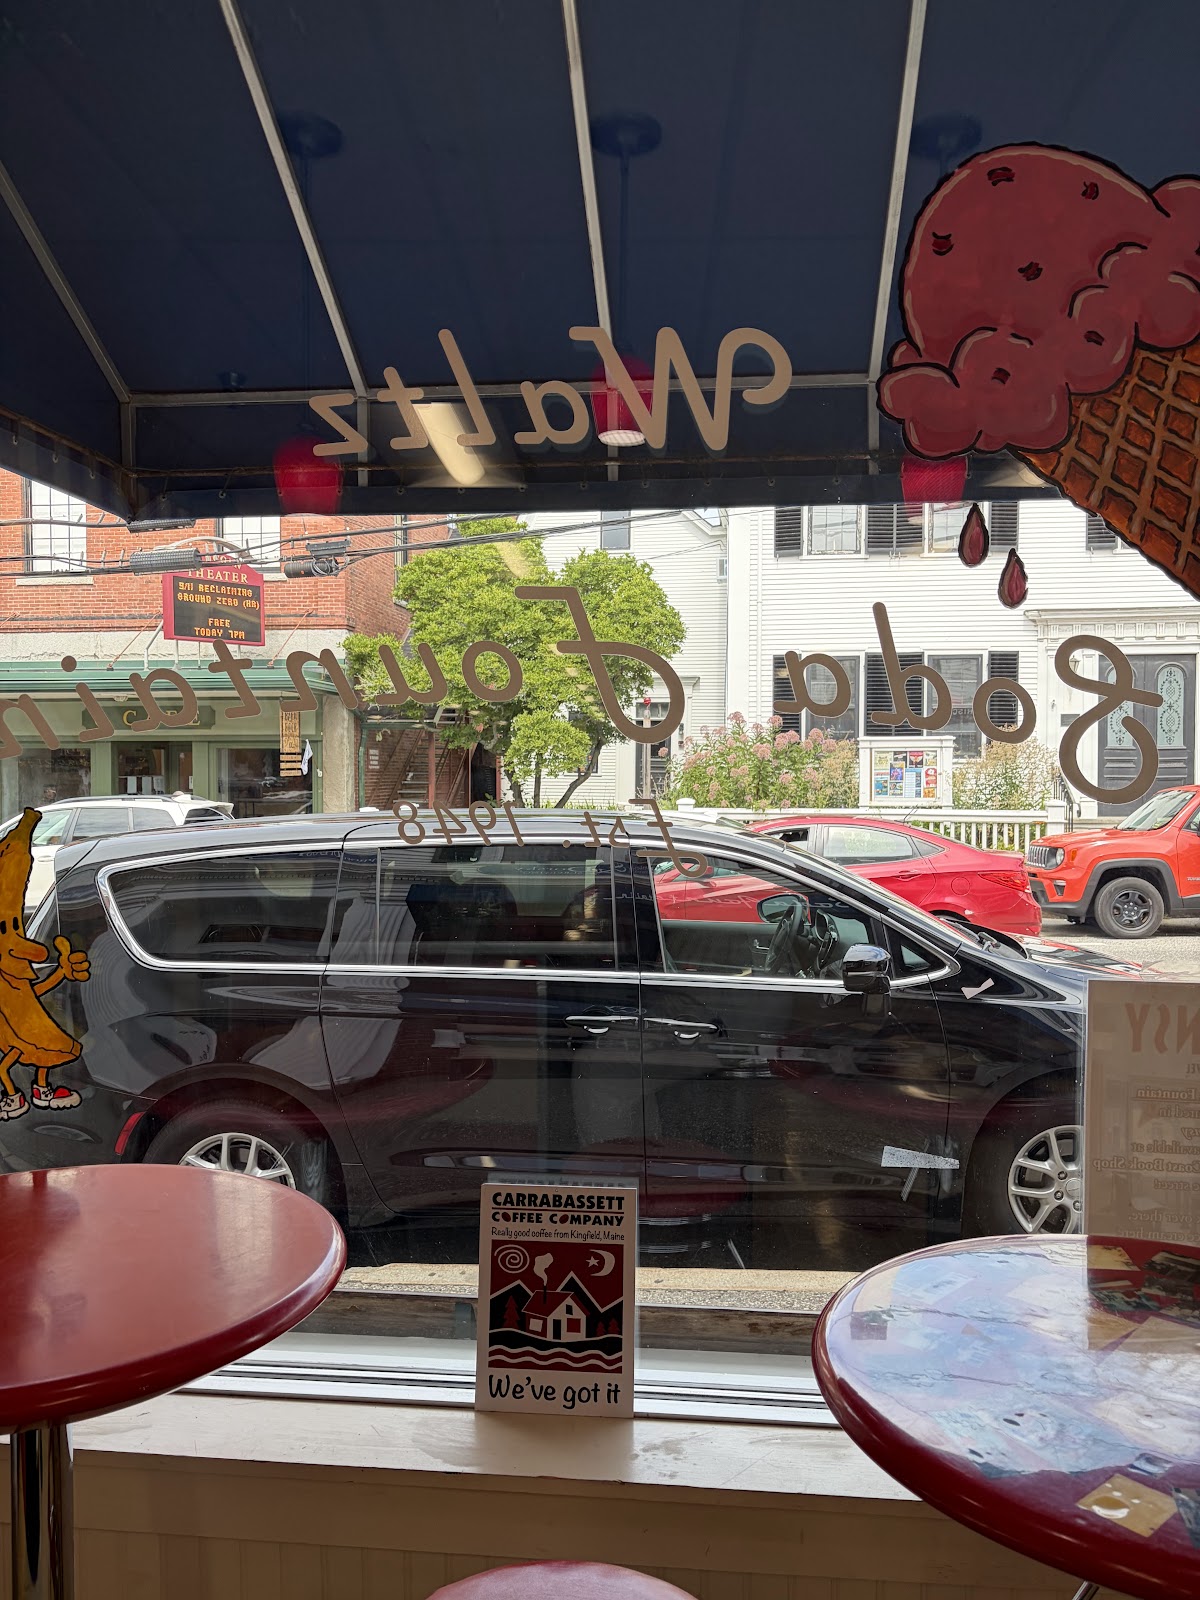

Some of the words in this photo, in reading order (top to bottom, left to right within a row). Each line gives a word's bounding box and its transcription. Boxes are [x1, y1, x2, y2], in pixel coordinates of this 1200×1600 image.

[188, 568, 249, 584] THEATER
[178, 581, 194, 591] 9/11
[198, 583, 253, 598] RECLAIMING
[177, 592, 212, 604] GROUND
[216, 596, 239, 607] ZERO
[208, 618, 231, 627] FREE
[194, 627, 223, 637] TODAY
[228, 629, 245, 640] 7PM
[491, 1191, 625, 1211] CARRABASSETT
[491, 1211, 543, 1224] COFFEE
[549, 1213, 625, 1227] COMPANY
[491, 1226, 513, 1239] Really
[513, 1228, 531, 1239] good
[531, 1229, 553, 1238] coffee
[553, 1229, 570, 1239] from
[570, 1230, 602, 1242] Kingfield,
[603, 1231, 625, 1241] Maine
[489, 1374, 556, 1401] We've
[563, 1382, 600, 1410] got
[606, 1382, 621, 1404] it
